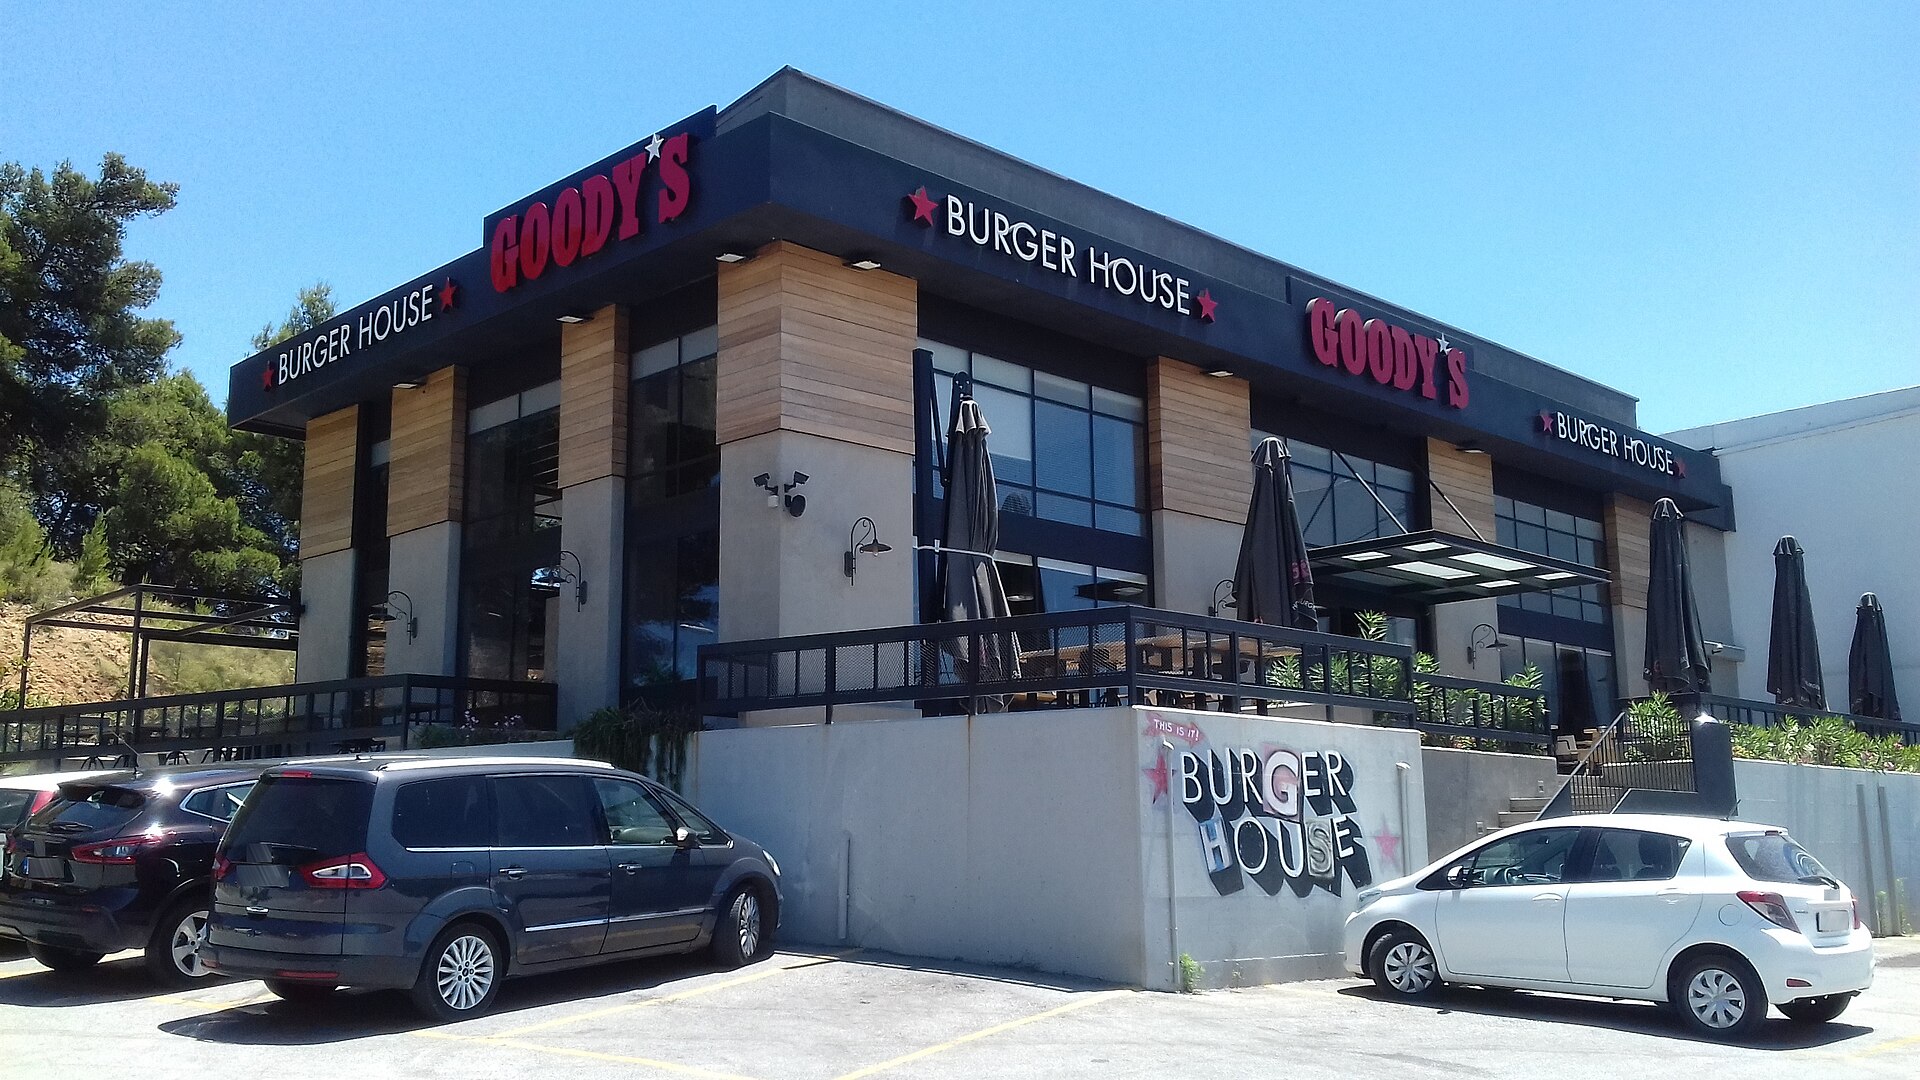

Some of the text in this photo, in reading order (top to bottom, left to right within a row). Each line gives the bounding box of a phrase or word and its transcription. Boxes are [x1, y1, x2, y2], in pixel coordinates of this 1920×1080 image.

[490, 131, 691, 293] GOODY'S
[947, 194, 1190, 315] BURGER HOUSE
[278, 284, 433, 386] BURGER HOUSE
[1305, 296, 1469, 410] GOODY'S
[1557, 411, 1674, 475] BURGER HOUSE
[1153, 718, 1199, 742] THIS IS IT!
[1180, 748, 1355, 879] BURGER HOUSE
